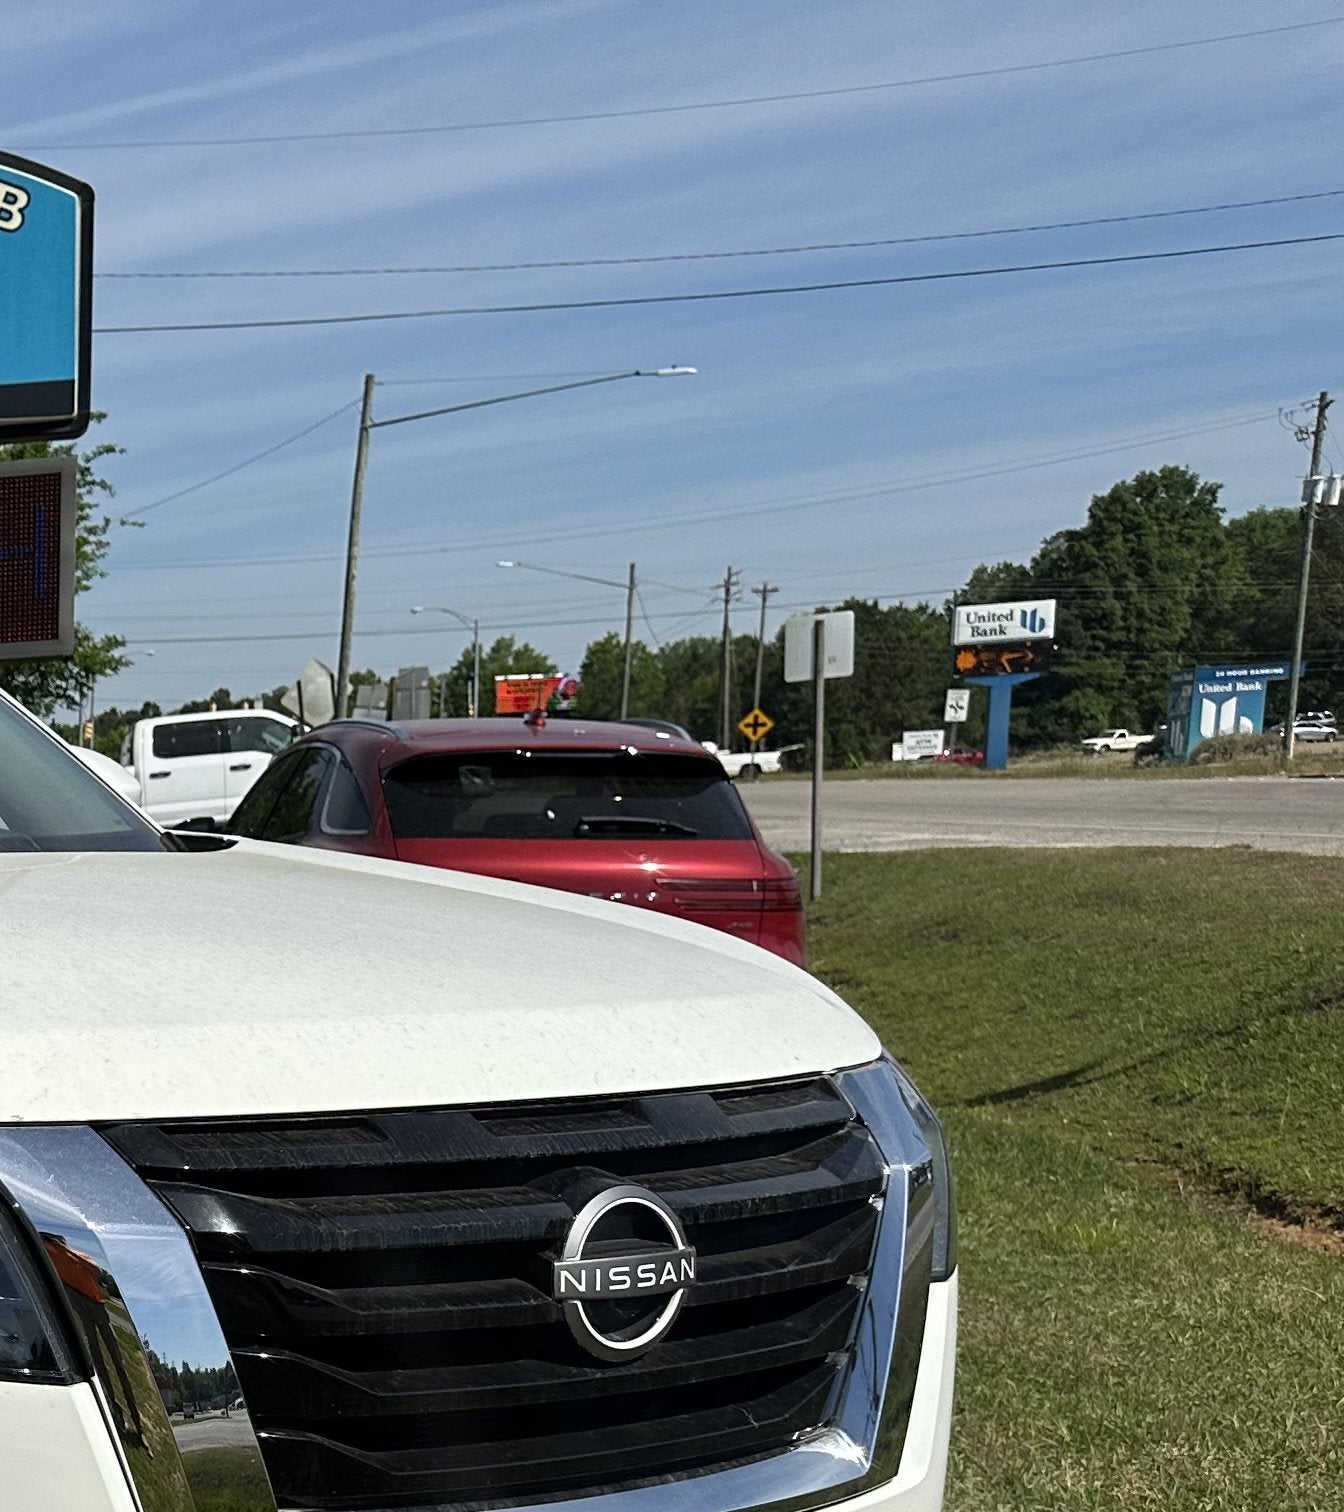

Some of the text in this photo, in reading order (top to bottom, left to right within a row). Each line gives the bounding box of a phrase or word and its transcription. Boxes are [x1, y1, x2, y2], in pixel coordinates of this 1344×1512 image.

[965, 609, 1014, 624] United
[970, 624, 1007, 637] Bank
[1198, 681, 1262, 694] United Bank
[559, 1257, 695, 1293] NISSAN
